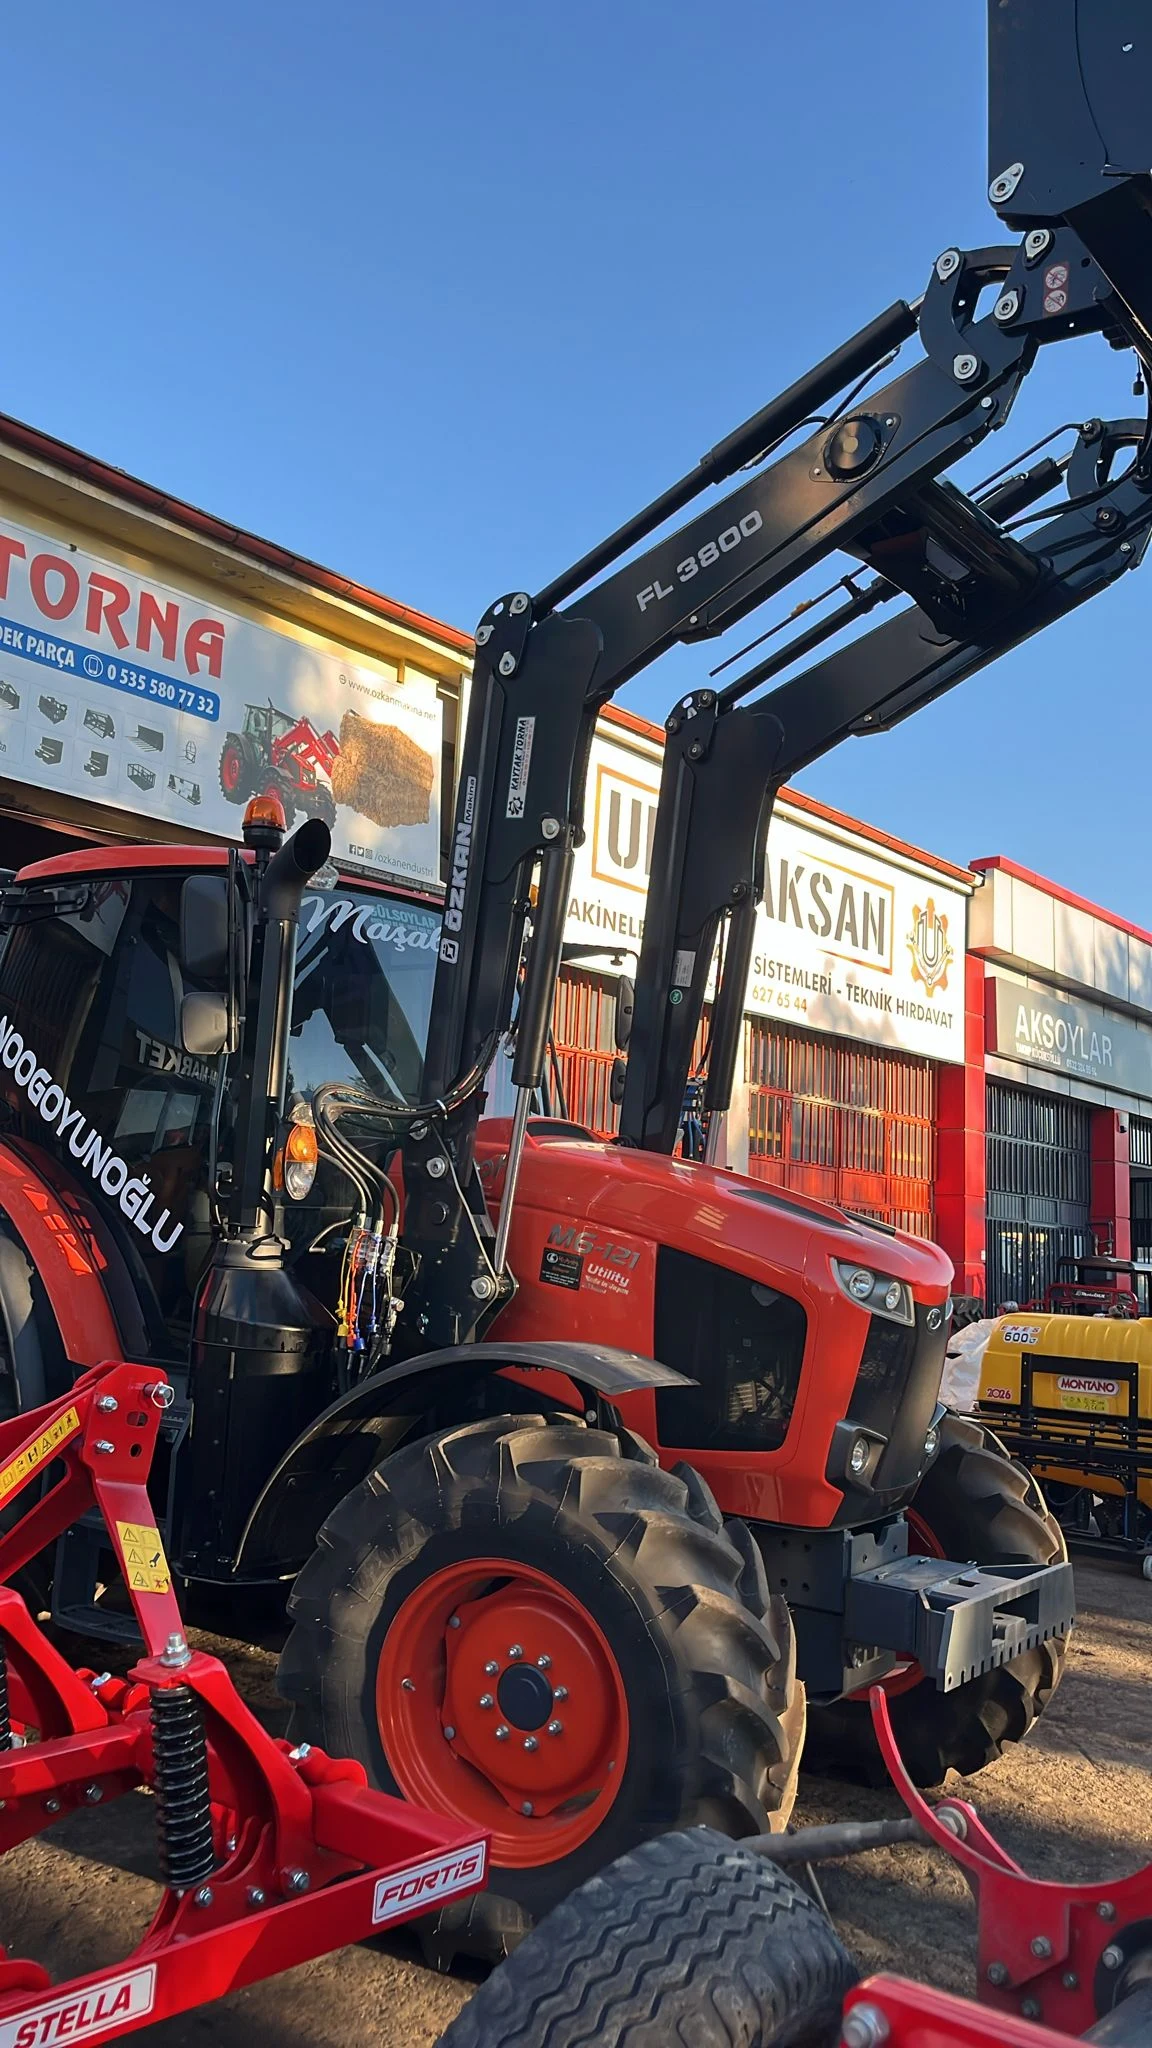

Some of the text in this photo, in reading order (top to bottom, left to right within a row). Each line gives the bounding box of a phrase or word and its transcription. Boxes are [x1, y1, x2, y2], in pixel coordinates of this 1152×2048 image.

[636, 510, 763, 612] FL 3800
[0, 535, 225, 679] TORNA
[26, 635, 75, 668] PARÇA
[107, 664, 116, 680] 0
[119, 667, 146, 690] 535
[149, 681, 175, 700] 580
[178, 688, 195, 708] 77
[197, 695, 214, 715] 32
[516, 719, 527, 749] TORNA
[510, 750, 523, 791] KAYTAK
[465, 778, 476, 821] Makina
[752, 986, 808, 1013] 627 65 44
[754, 953, 832, 996] SİSTEMLERİ
[846, 983, 892, 1013] TEKNİK
[896, 998, 953, 1030] HIRDAVAT
[1015, 1005, 1113, 1067] AKSOYLAR
[547, 1223, 641, 1270] M6-121
[587, 1263, 630, 1287] Utility
[986, 1388, 1012, 1400] 2026
[1061, 1377, 1115, 1393] MONTANO
[15, 1983, 132, 2048] STELLA
